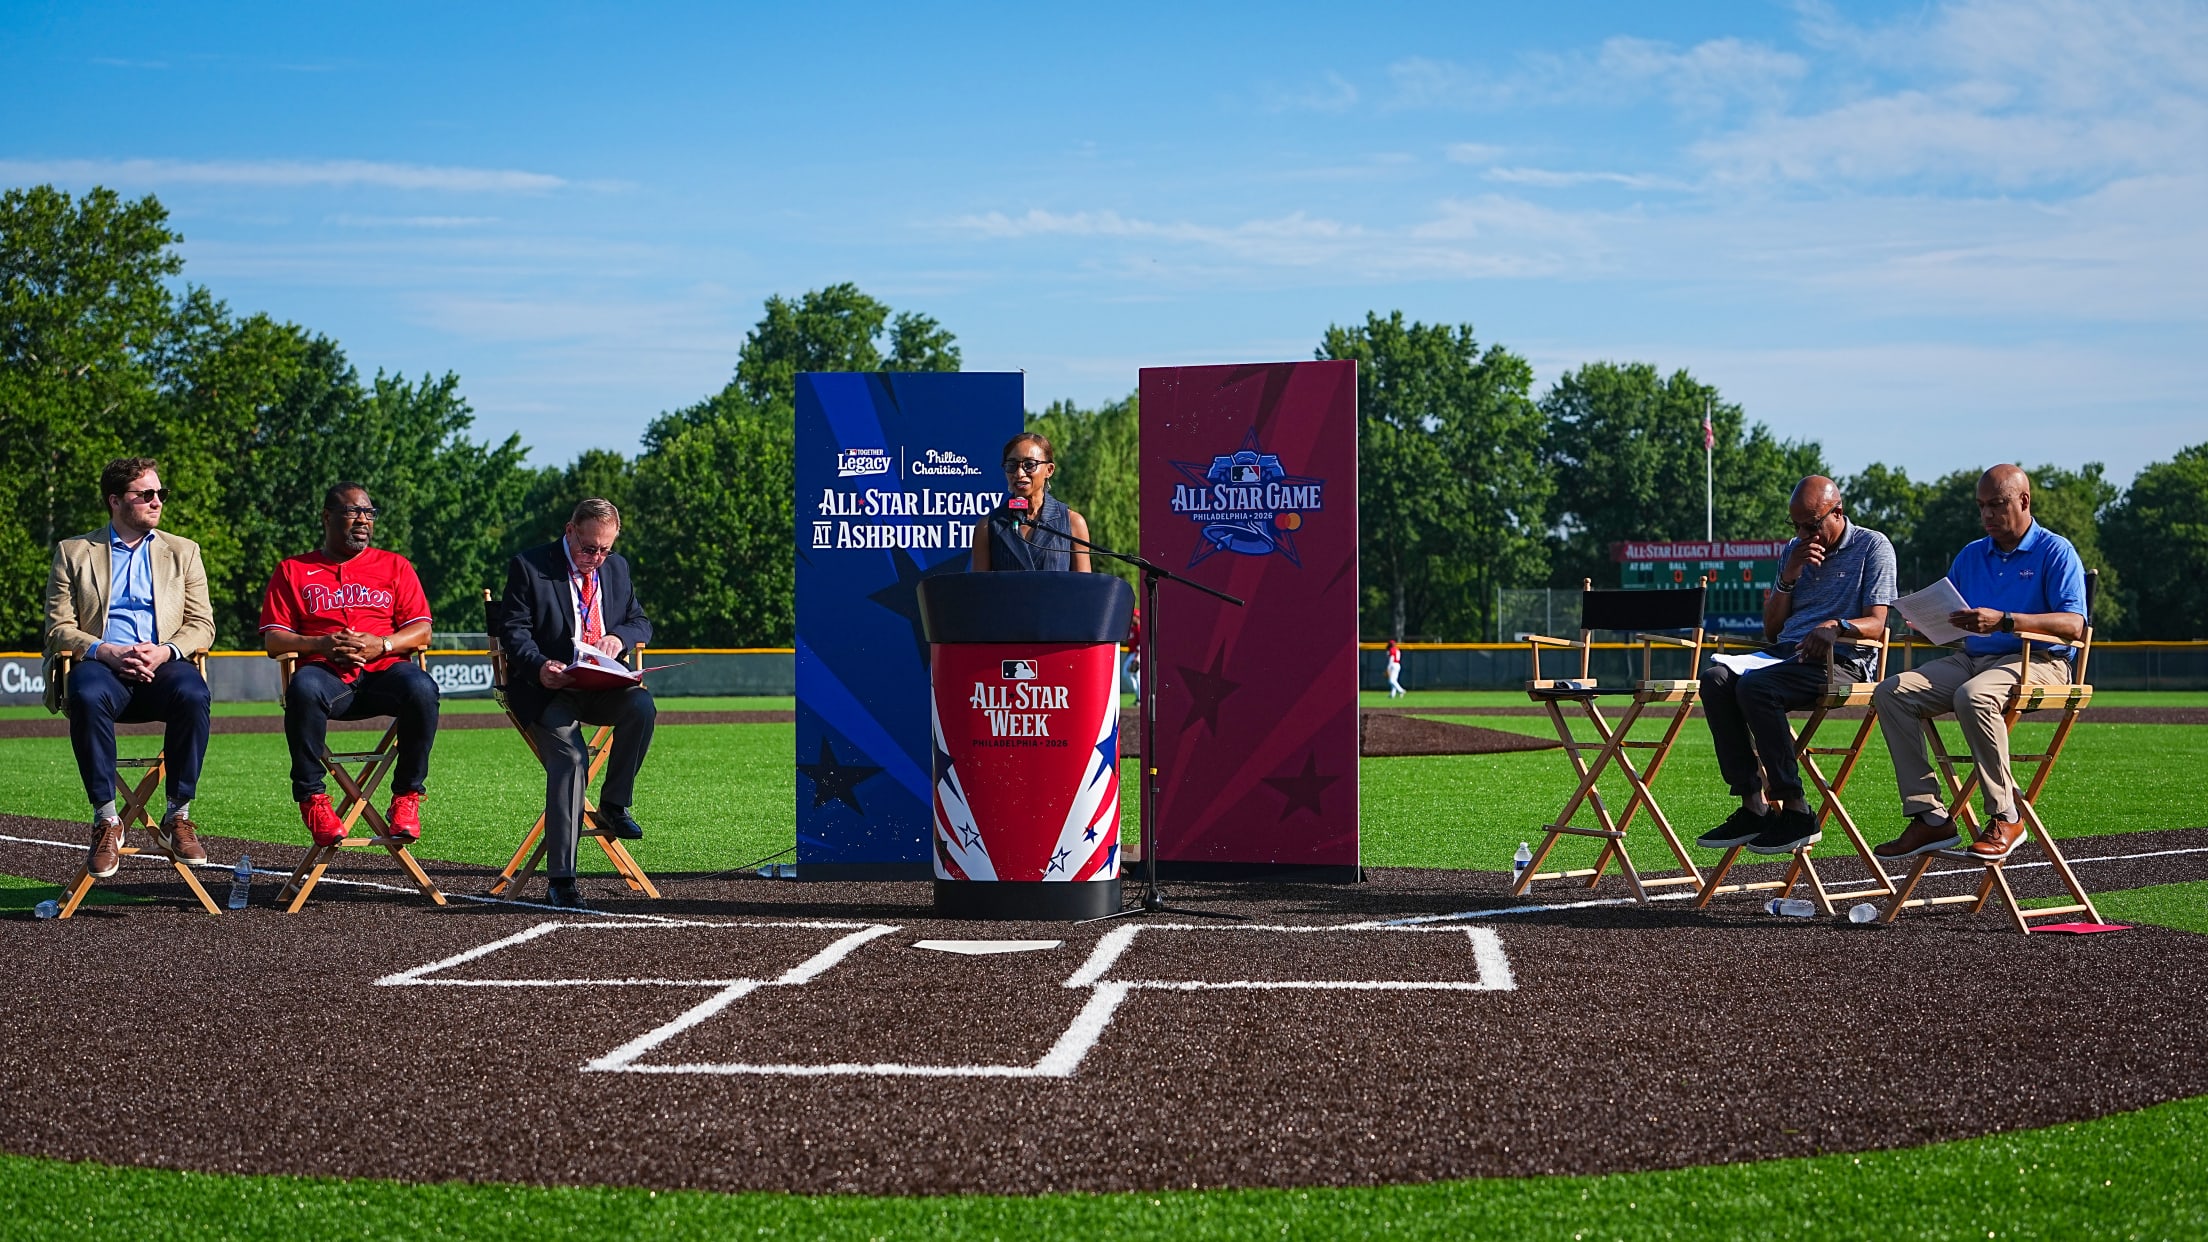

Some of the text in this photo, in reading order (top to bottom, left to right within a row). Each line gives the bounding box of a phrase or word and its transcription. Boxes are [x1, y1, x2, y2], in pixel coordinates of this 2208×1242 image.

[838, 453, 892, 474] Legacy
[926, 449, 967, 464] Phillies
[963, 464, 982, 475] Inc.
[922, 488, 1004, 516] LEGACY
[1266, 483, 1321, 510] GAME
[1193, 512, 1273, 521] PHILADELPHIA 2026
[813, 522, 832, 547] AT
[837, 521, 943, 549] ASHBURN
[1672, 544, 1710, 558] LEGACY
[1723, 543, 1772, 557] ASHBURN
[1674, 569, 1683, 583] 0
[1709, 569, 1717, 583] 0
[1743, 569, 1752, 583] 0
[302, 583, 393, 614] Phillies
[1, 661, 46, 693] Cha
[430, 663, 494, 688] egacy
[984, 710, 1050, 737] WEEK
[1045, 739, 1068, 747] 2026
